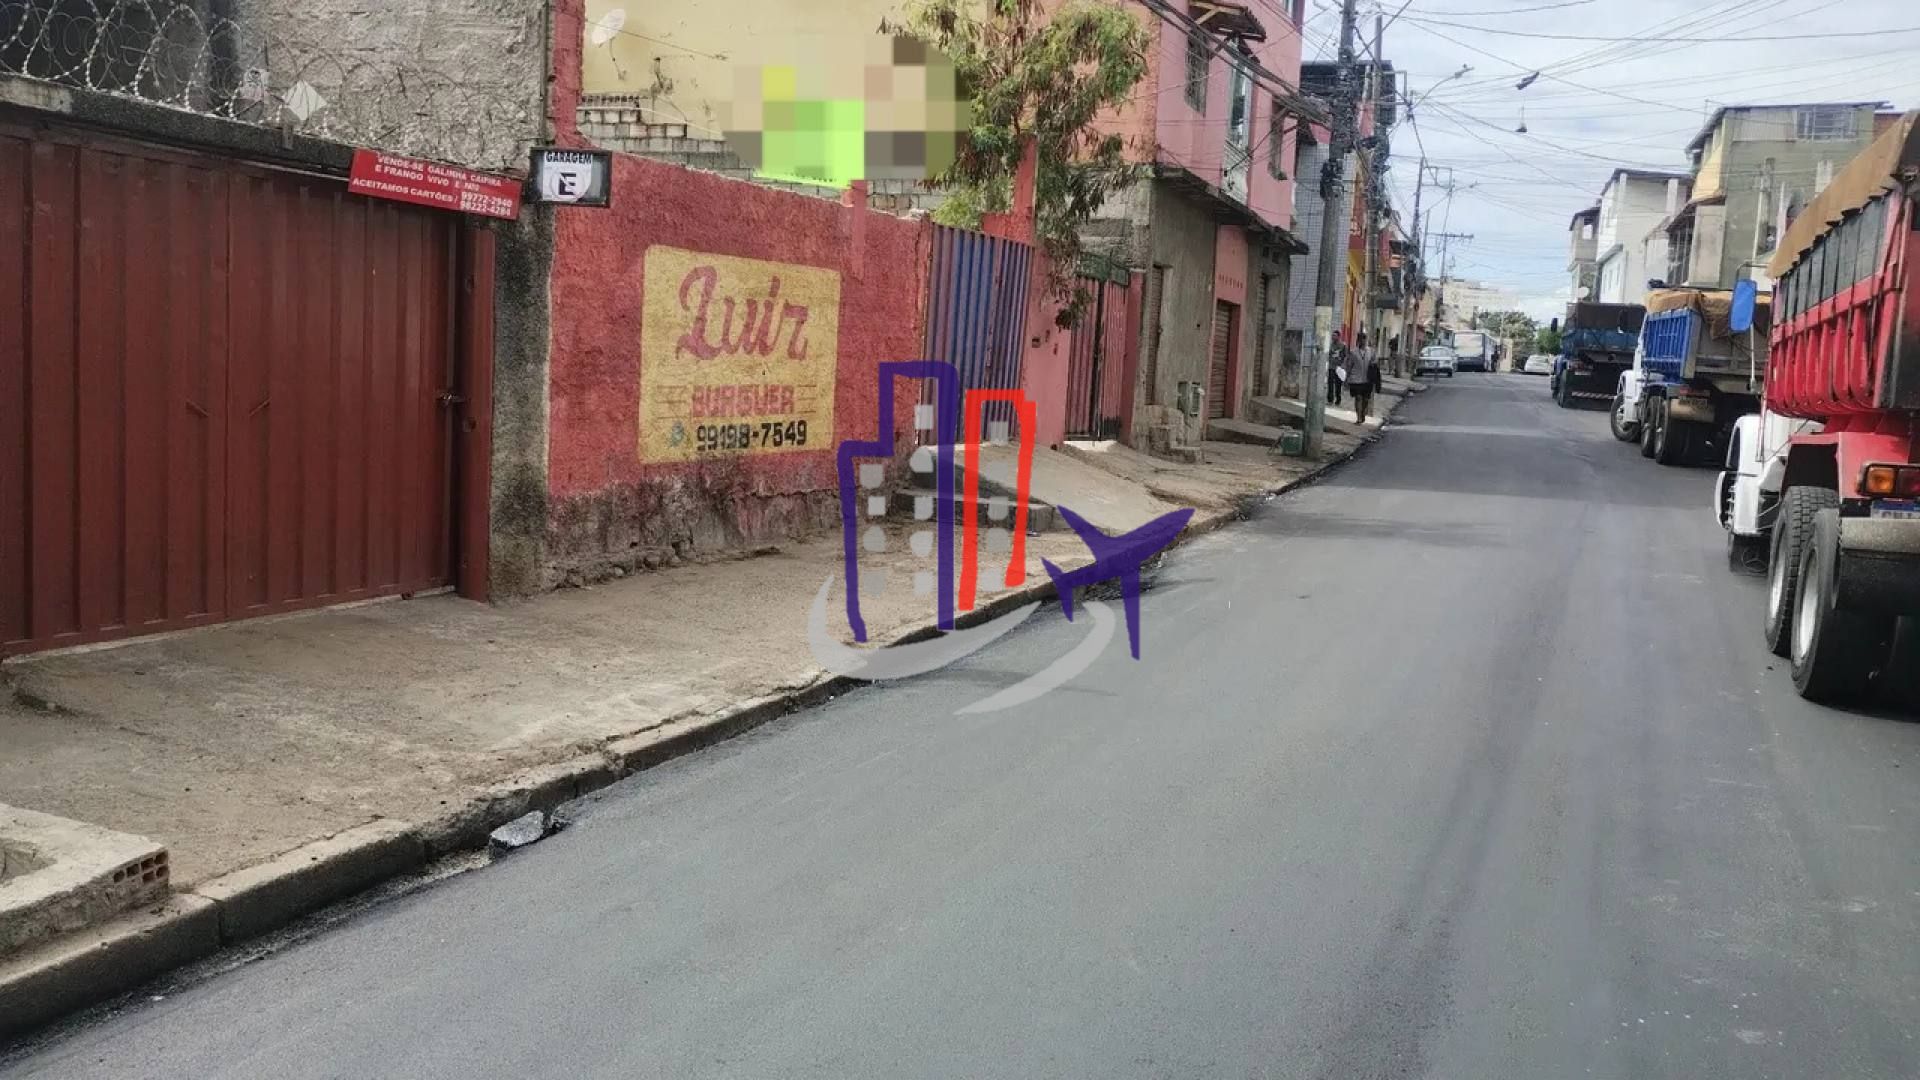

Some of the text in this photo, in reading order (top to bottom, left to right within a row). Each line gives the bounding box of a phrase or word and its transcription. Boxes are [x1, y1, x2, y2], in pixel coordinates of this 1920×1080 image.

[545, 150, 593, 164] GARAGEM
[374, 164, 383, 173] E
[383, 165, 424, 181] FRANGO
[427, 174, 450, 187] VIVO
[376, 152, 502, 187] VENDE-SE GALINHA CAIPIRA
[352, 177, 409, 194] ACEITAMOS
[697, 419, 808, 452] 99198-7549
